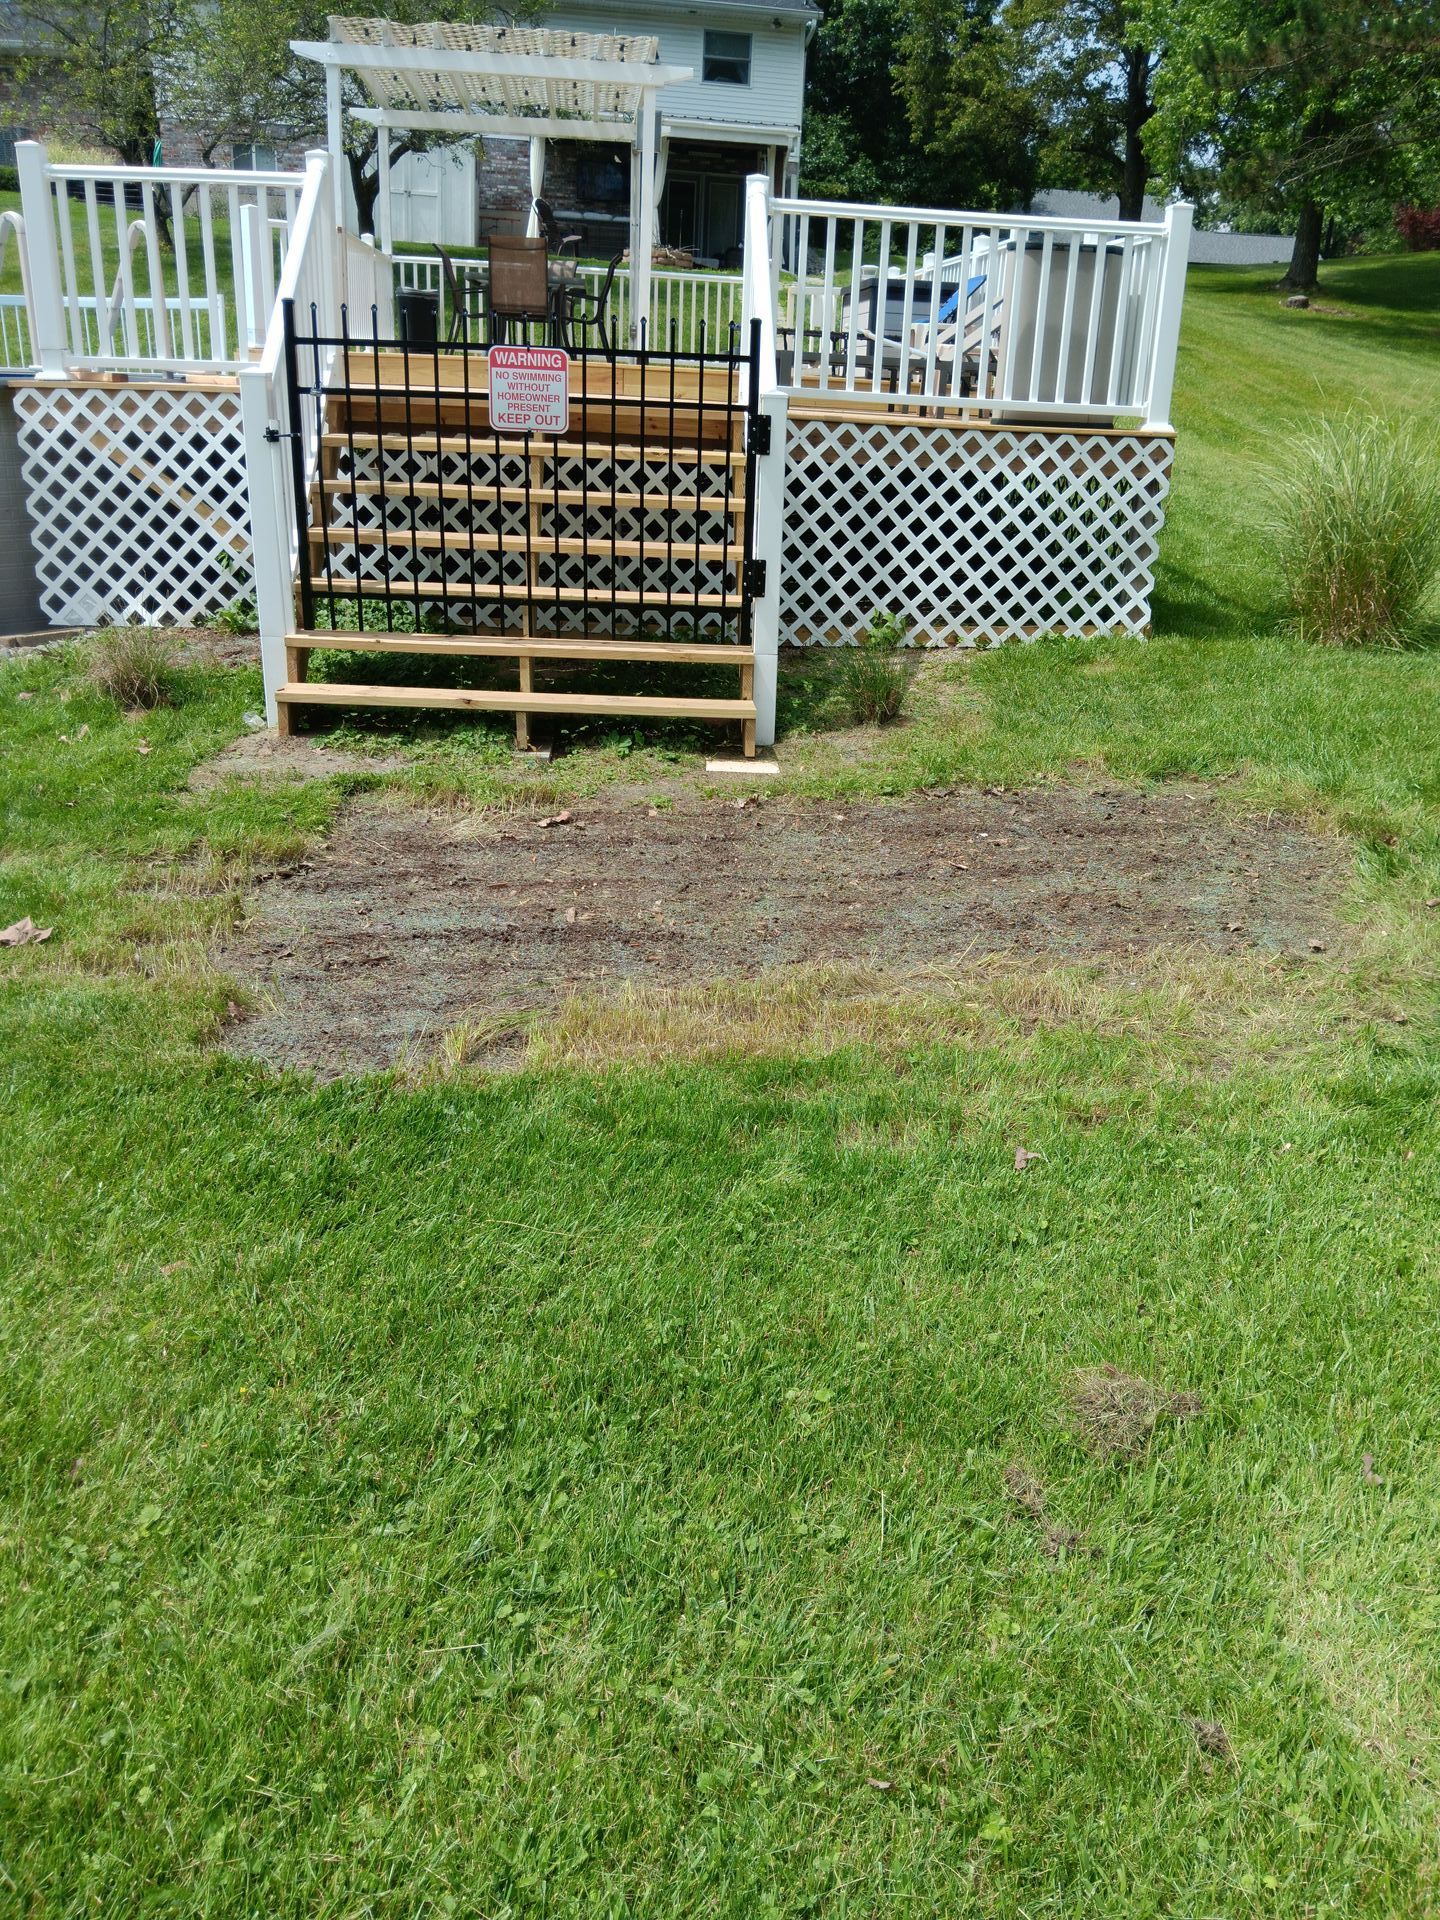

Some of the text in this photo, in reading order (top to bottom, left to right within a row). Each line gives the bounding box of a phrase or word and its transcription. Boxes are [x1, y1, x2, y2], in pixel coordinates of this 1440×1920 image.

[495, 351, 562, 368] WARNING
[496, 371, 562, 382] NO SWIMMING
[507, 382, 550, 392] WITHOUT
[497, 392, 560, 403] HOMEOWNER
[507, 403, 550, 412] PRESENT
[498, 412, 561, 426] KEEP OUT
